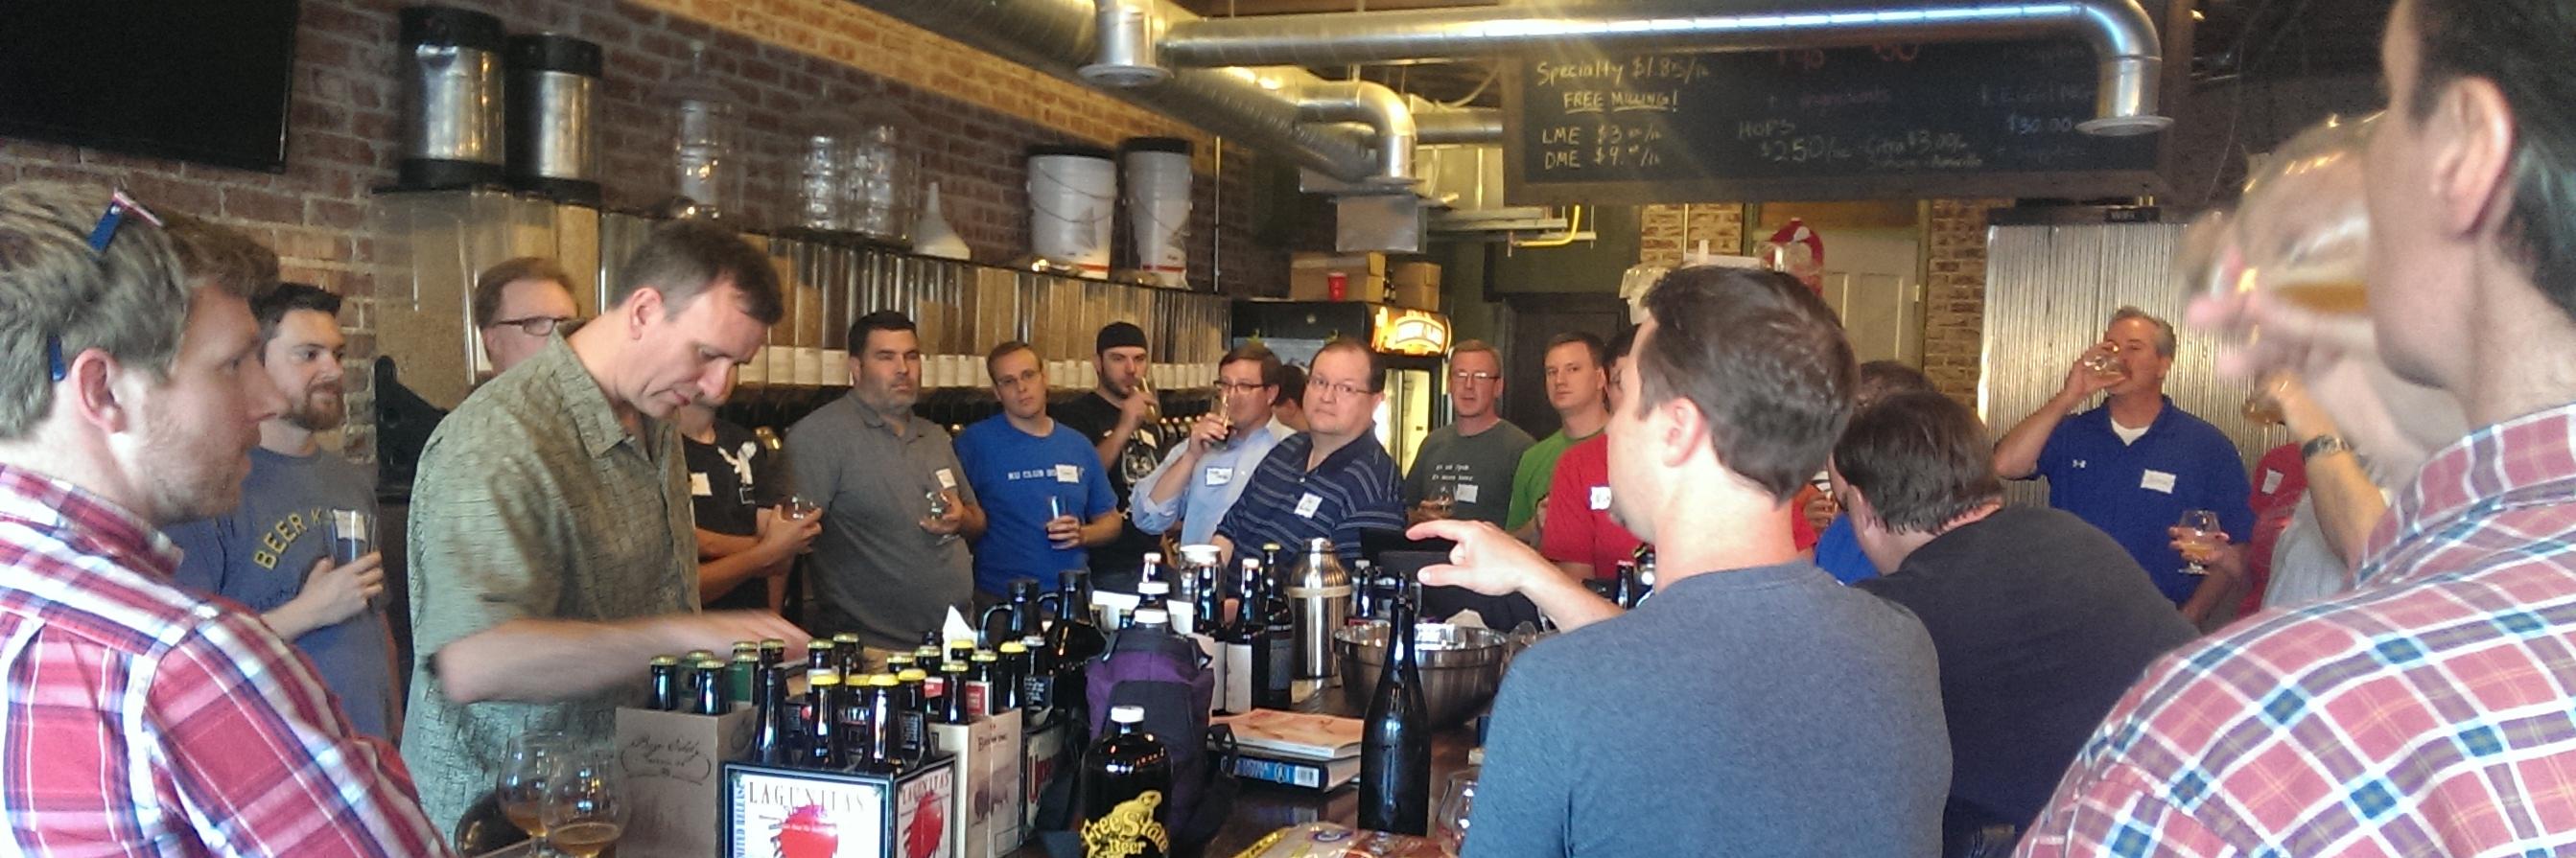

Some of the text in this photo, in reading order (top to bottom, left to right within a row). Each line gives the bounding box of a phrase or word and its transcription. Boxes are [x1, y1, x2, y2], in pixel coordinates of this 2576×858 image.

[1536, 60, 1625, 87] Specialty
[1563, 90, 1679, 113] FREE MILLING!
[1541, 126, 1581, 145] LME
[1544, 149, 1581, 171] DME
[252, 512, 307, 570] BEER
[749, 781, 866, 813] LAGUNITAS
[1081, 810, 1169, 853] Free State
[1109, 838, 1147, 854] Beer
